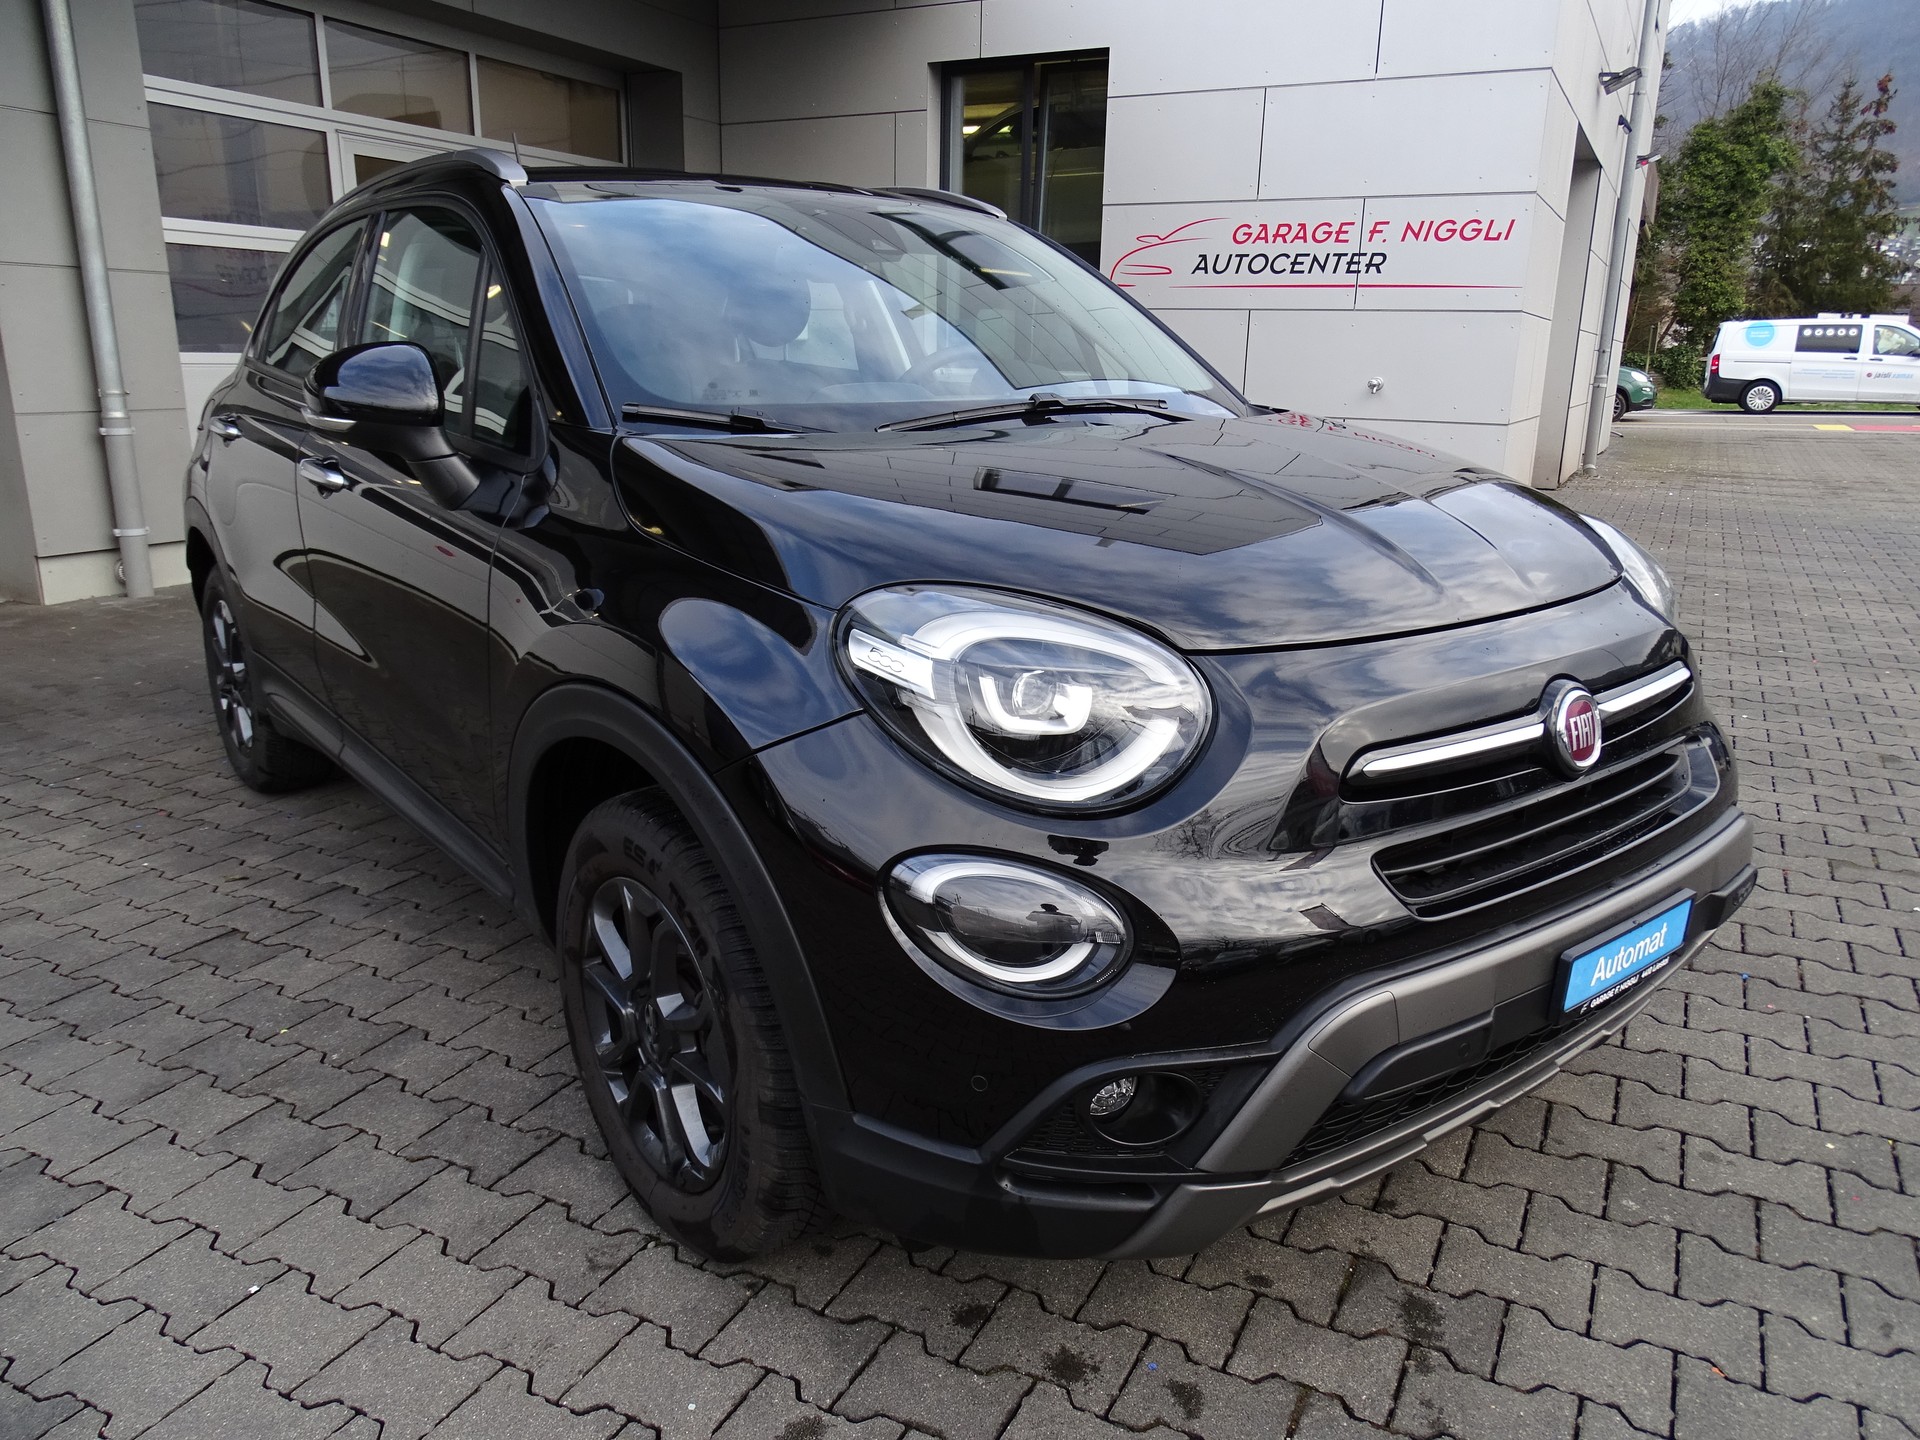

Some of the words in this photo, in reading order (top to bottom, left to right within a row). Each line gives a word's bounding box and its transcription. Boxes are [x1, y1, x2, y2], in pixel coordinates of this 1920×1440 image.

[1232, 222, 1355, 244] GARAGE
[1368, 221, 1390, 243] F.
[1400, 218, 1515, 243] NIGGLI
[1191, 253, 1387, 275] AUTOCENTER
[1569, 711, 1594, 752] FIAT
[1590, 922, 1668, 987] Automat
